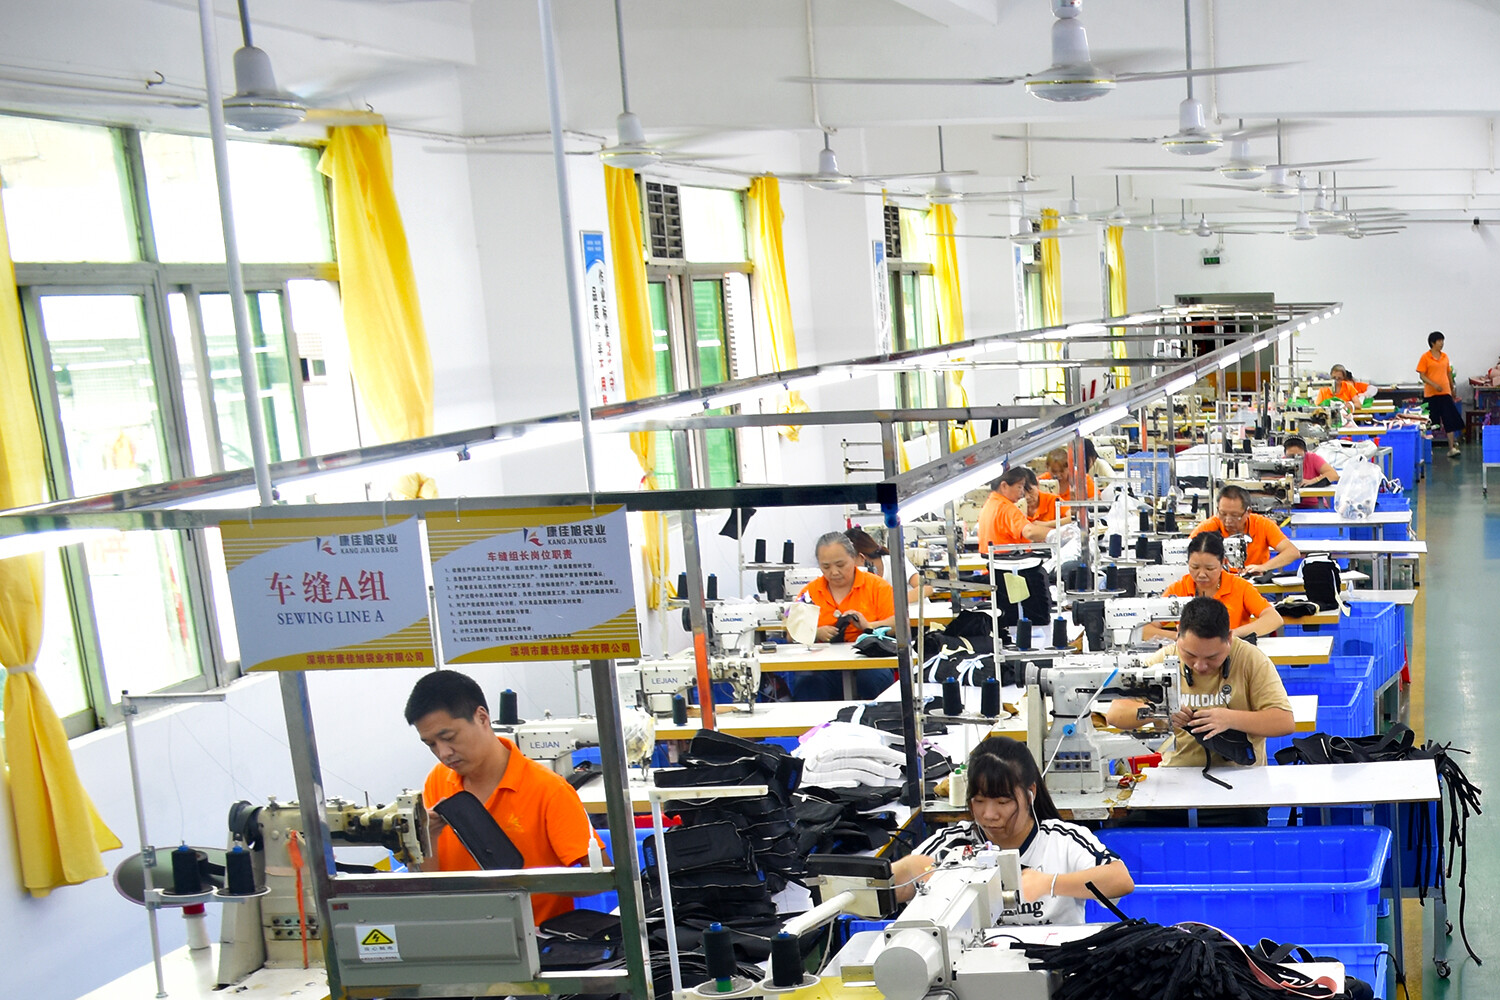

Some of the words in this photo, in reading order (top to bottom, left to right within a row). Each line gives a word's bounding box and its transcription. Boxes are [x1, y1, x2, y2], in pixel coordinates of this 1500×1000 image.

[546, 524, 606, 538] 康佳旭袋业
[339, 534, 398, 546] 康佳旭袋业
[381, 545, 399, 553] BAGS
[487, 549, 573, 562] 车缝组长岗位职责
[264, 569, 389, 606] 车缝A组
[277, 611, 334, 625] SEWING
[337, 610, 372, 624] LINE
[375, 610, 385, 623] A
[510, 642, 631, 657] 深圳市康佳旭袋业有限公司
[306, 652, 425, 665] 深圳市康佳旭袋业有限公司
[651, 677, 678, 685] LEJIAN
